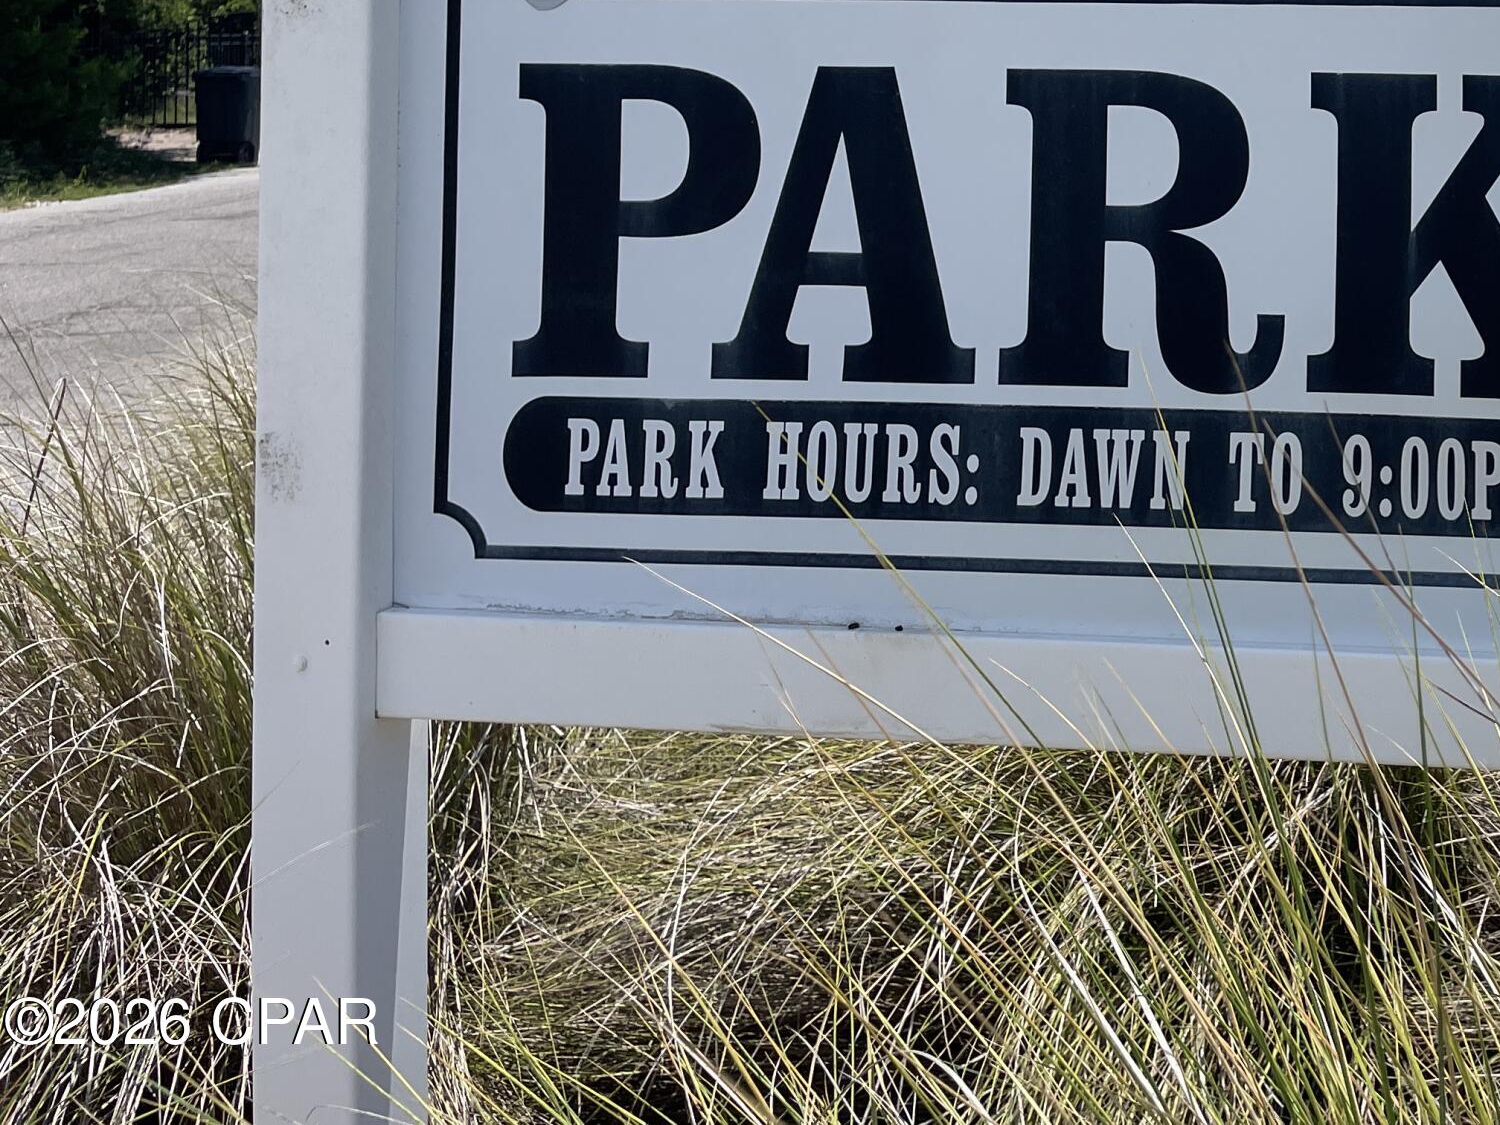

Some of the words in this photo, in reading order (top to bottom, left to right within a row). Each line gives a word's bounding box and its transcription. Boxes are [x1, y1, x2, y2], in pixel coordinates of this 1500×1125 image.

[564, 418, 725, 500] PARK
[762, 420, 980, 506] HOURS:
[1016, 426, 1191, 511] DAWN
[1228, 431, 1303, 516] TO
